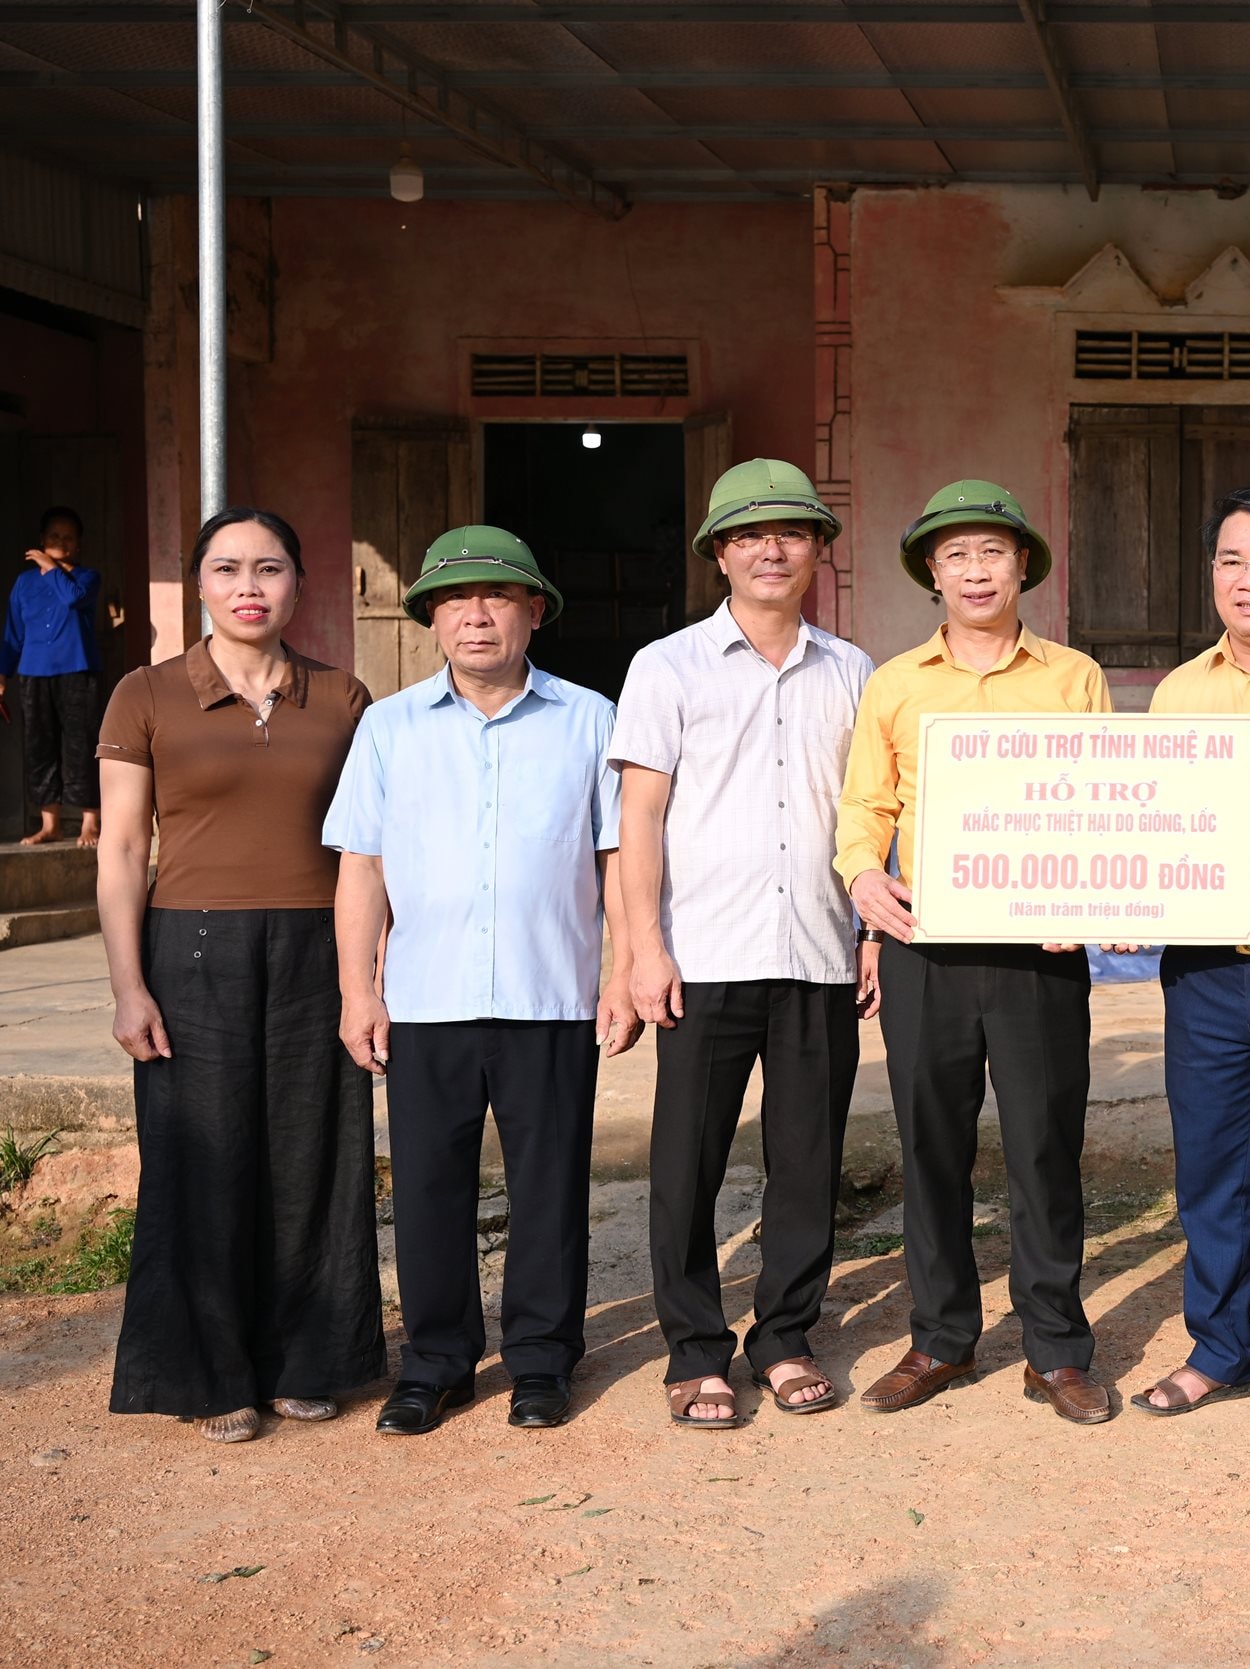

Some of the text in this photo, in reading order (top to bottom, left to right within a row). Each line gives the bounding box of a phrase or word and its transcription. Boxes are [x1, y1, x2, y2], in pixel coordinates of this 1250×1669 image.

[951, 726, 1233, 764] QUỸ CỨU TRỢ TỈNH NGHỆ AN
[1024, 773, 1158, 808] HỖ TRỢ
[963, 806, 999, 832] KHẮC
[1004, 813, 1041, 835] PHỤC
[1046, 809, 1083, 836] THIỆT
[1088, 813, 1111, 836] HẠI
[1115, 813, 1134, 832] DO
[1191, 807, 1216, 832] LỐC
[952, 854, 1225, 890] 500.000.000 ĐỒNG
[1009, 902, 1046, 917] (Năm
[1088, 902, 1120, 919] triệu
